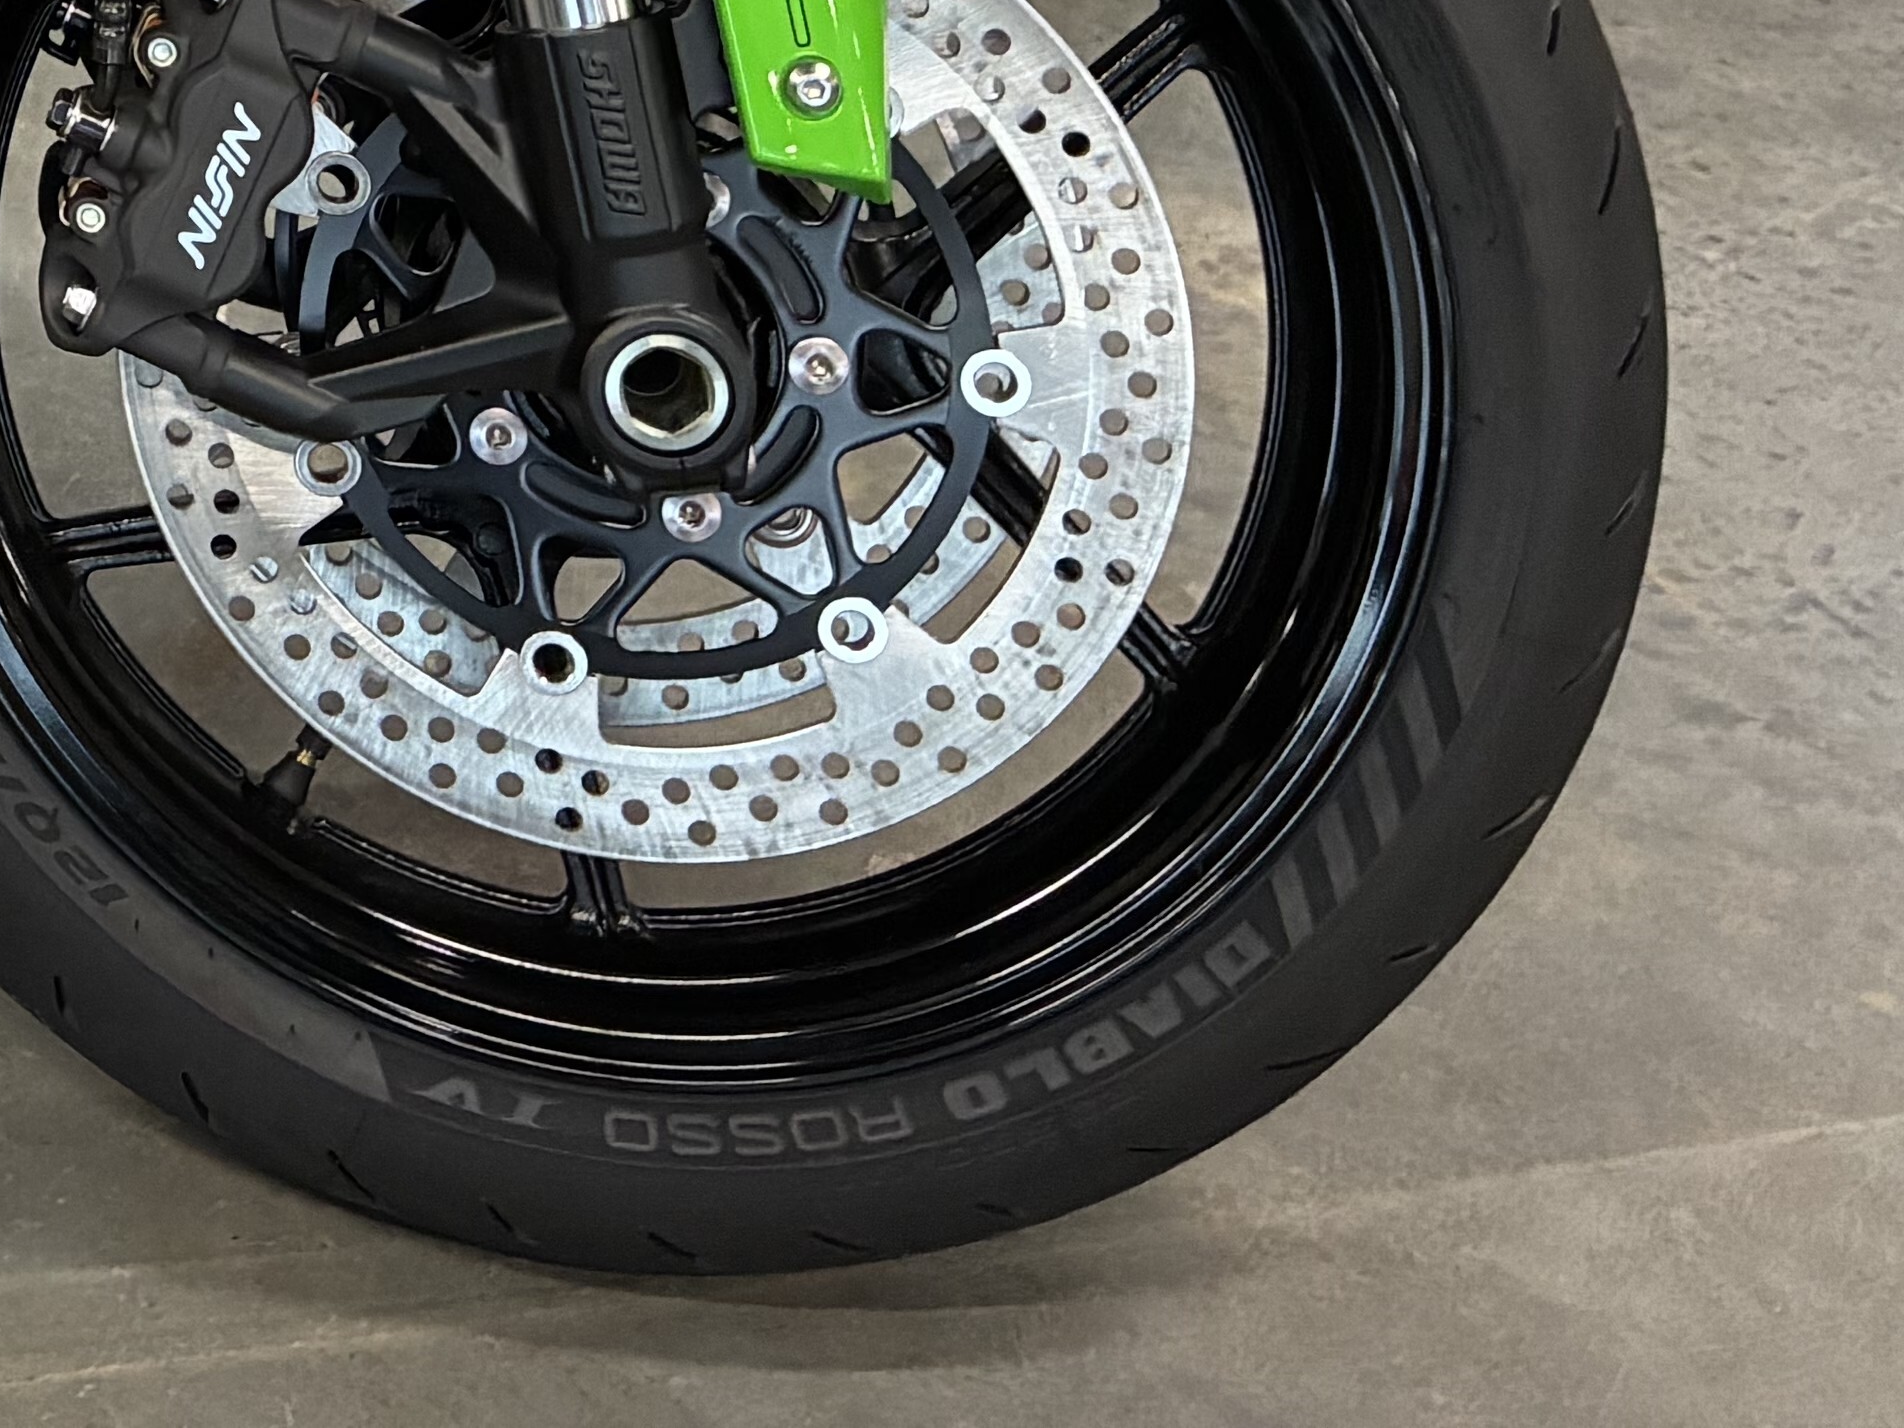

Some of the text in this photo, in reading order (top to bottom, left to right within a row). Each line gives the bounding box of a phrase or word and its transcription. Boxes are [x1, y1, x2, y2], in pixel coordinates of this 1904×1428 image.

[177, 101, 262, 271] NISSIN
[575, 48, 647, 217] SHOWA
[415, 1076, 564, 1129] IV
[942, 918, 1272, 1122] DIABLO
[603, 1104, 918, 1157] ROSSO
